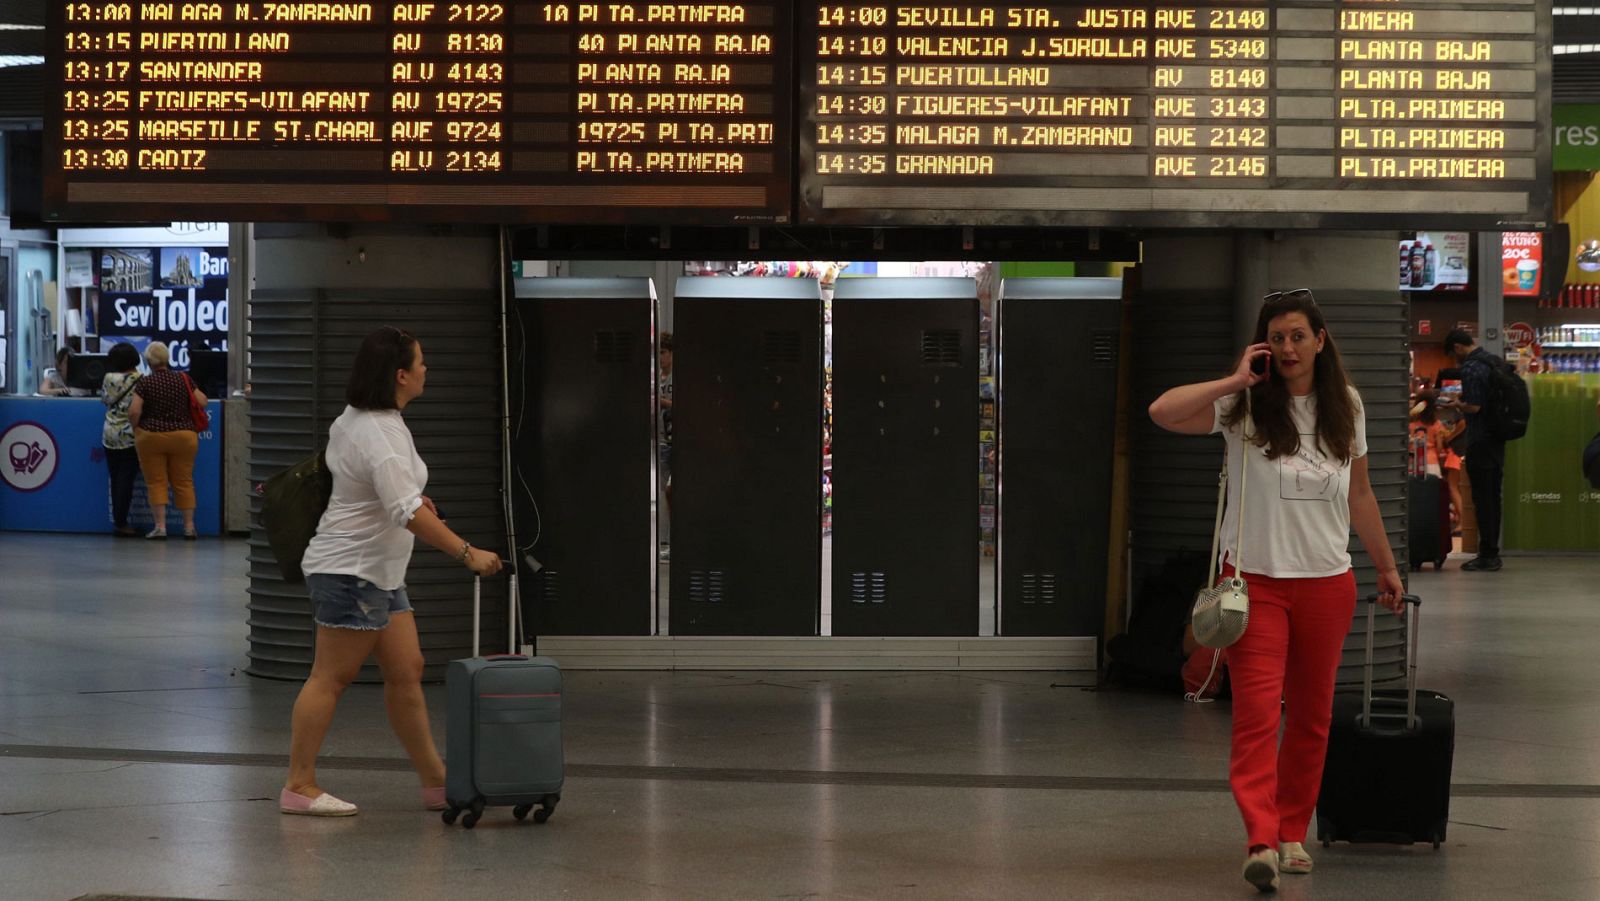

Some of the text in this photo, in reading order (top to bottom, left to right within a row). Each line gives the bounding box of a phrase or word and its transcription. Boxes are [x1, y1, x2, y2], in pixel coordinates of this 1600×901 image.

[819, 7, 887, 27] 14:00
[897, 8, 994, 27] SEVILLA
[1008, 8, 1061, 28] STA.
[1077, 9, 1146, 28] JUSTA
[1155, 9, 1196, 28] AVE
[1210, 10, 1265, 29] 2140
[65, 32, 130, 52] 13:15
[818, 37, 1491, 60] 14:10 VALENCIA J.SOROLLA AVE 5340 PLANTA BAJA
[65, 61, 130, 81] 13:17
[140, 61, 262, 82] SANTANDER
[447, 62, 503, 83] 4143
[818, 66, 1491, 90] 14:15 PUERTOLLANO AV 8140 PLANTA BAJA
[64, 91, 129, 111] 13:25
[435, 92, 502, 112] 19725
[818, 95, 1505, 119] 14:30 FIGUERES-VILAFANT AVE 3143 PLTA.PRIMERA
[64, 120, 129, 140] 13:25
[447, 121, 502, 142] 9724
[578, 122, 645, 142] 19725
[658, 123, 773, 143] PLTA.PRI
[818, 125, 1505, 148] 14:35 MALAGA M.ZAMBRANO AVE 2142 PLTA.PRIMERA
[1554, 125, 1599, 146] res
[63, 149, 128, 170] 13:30
[446, 151, 502, 171] 2134
[817, 155, 1505, 178] 14:35 GRANADA AVE 2146 PLTA.PRIMERA
[200, 251, 229, 276] Bar
